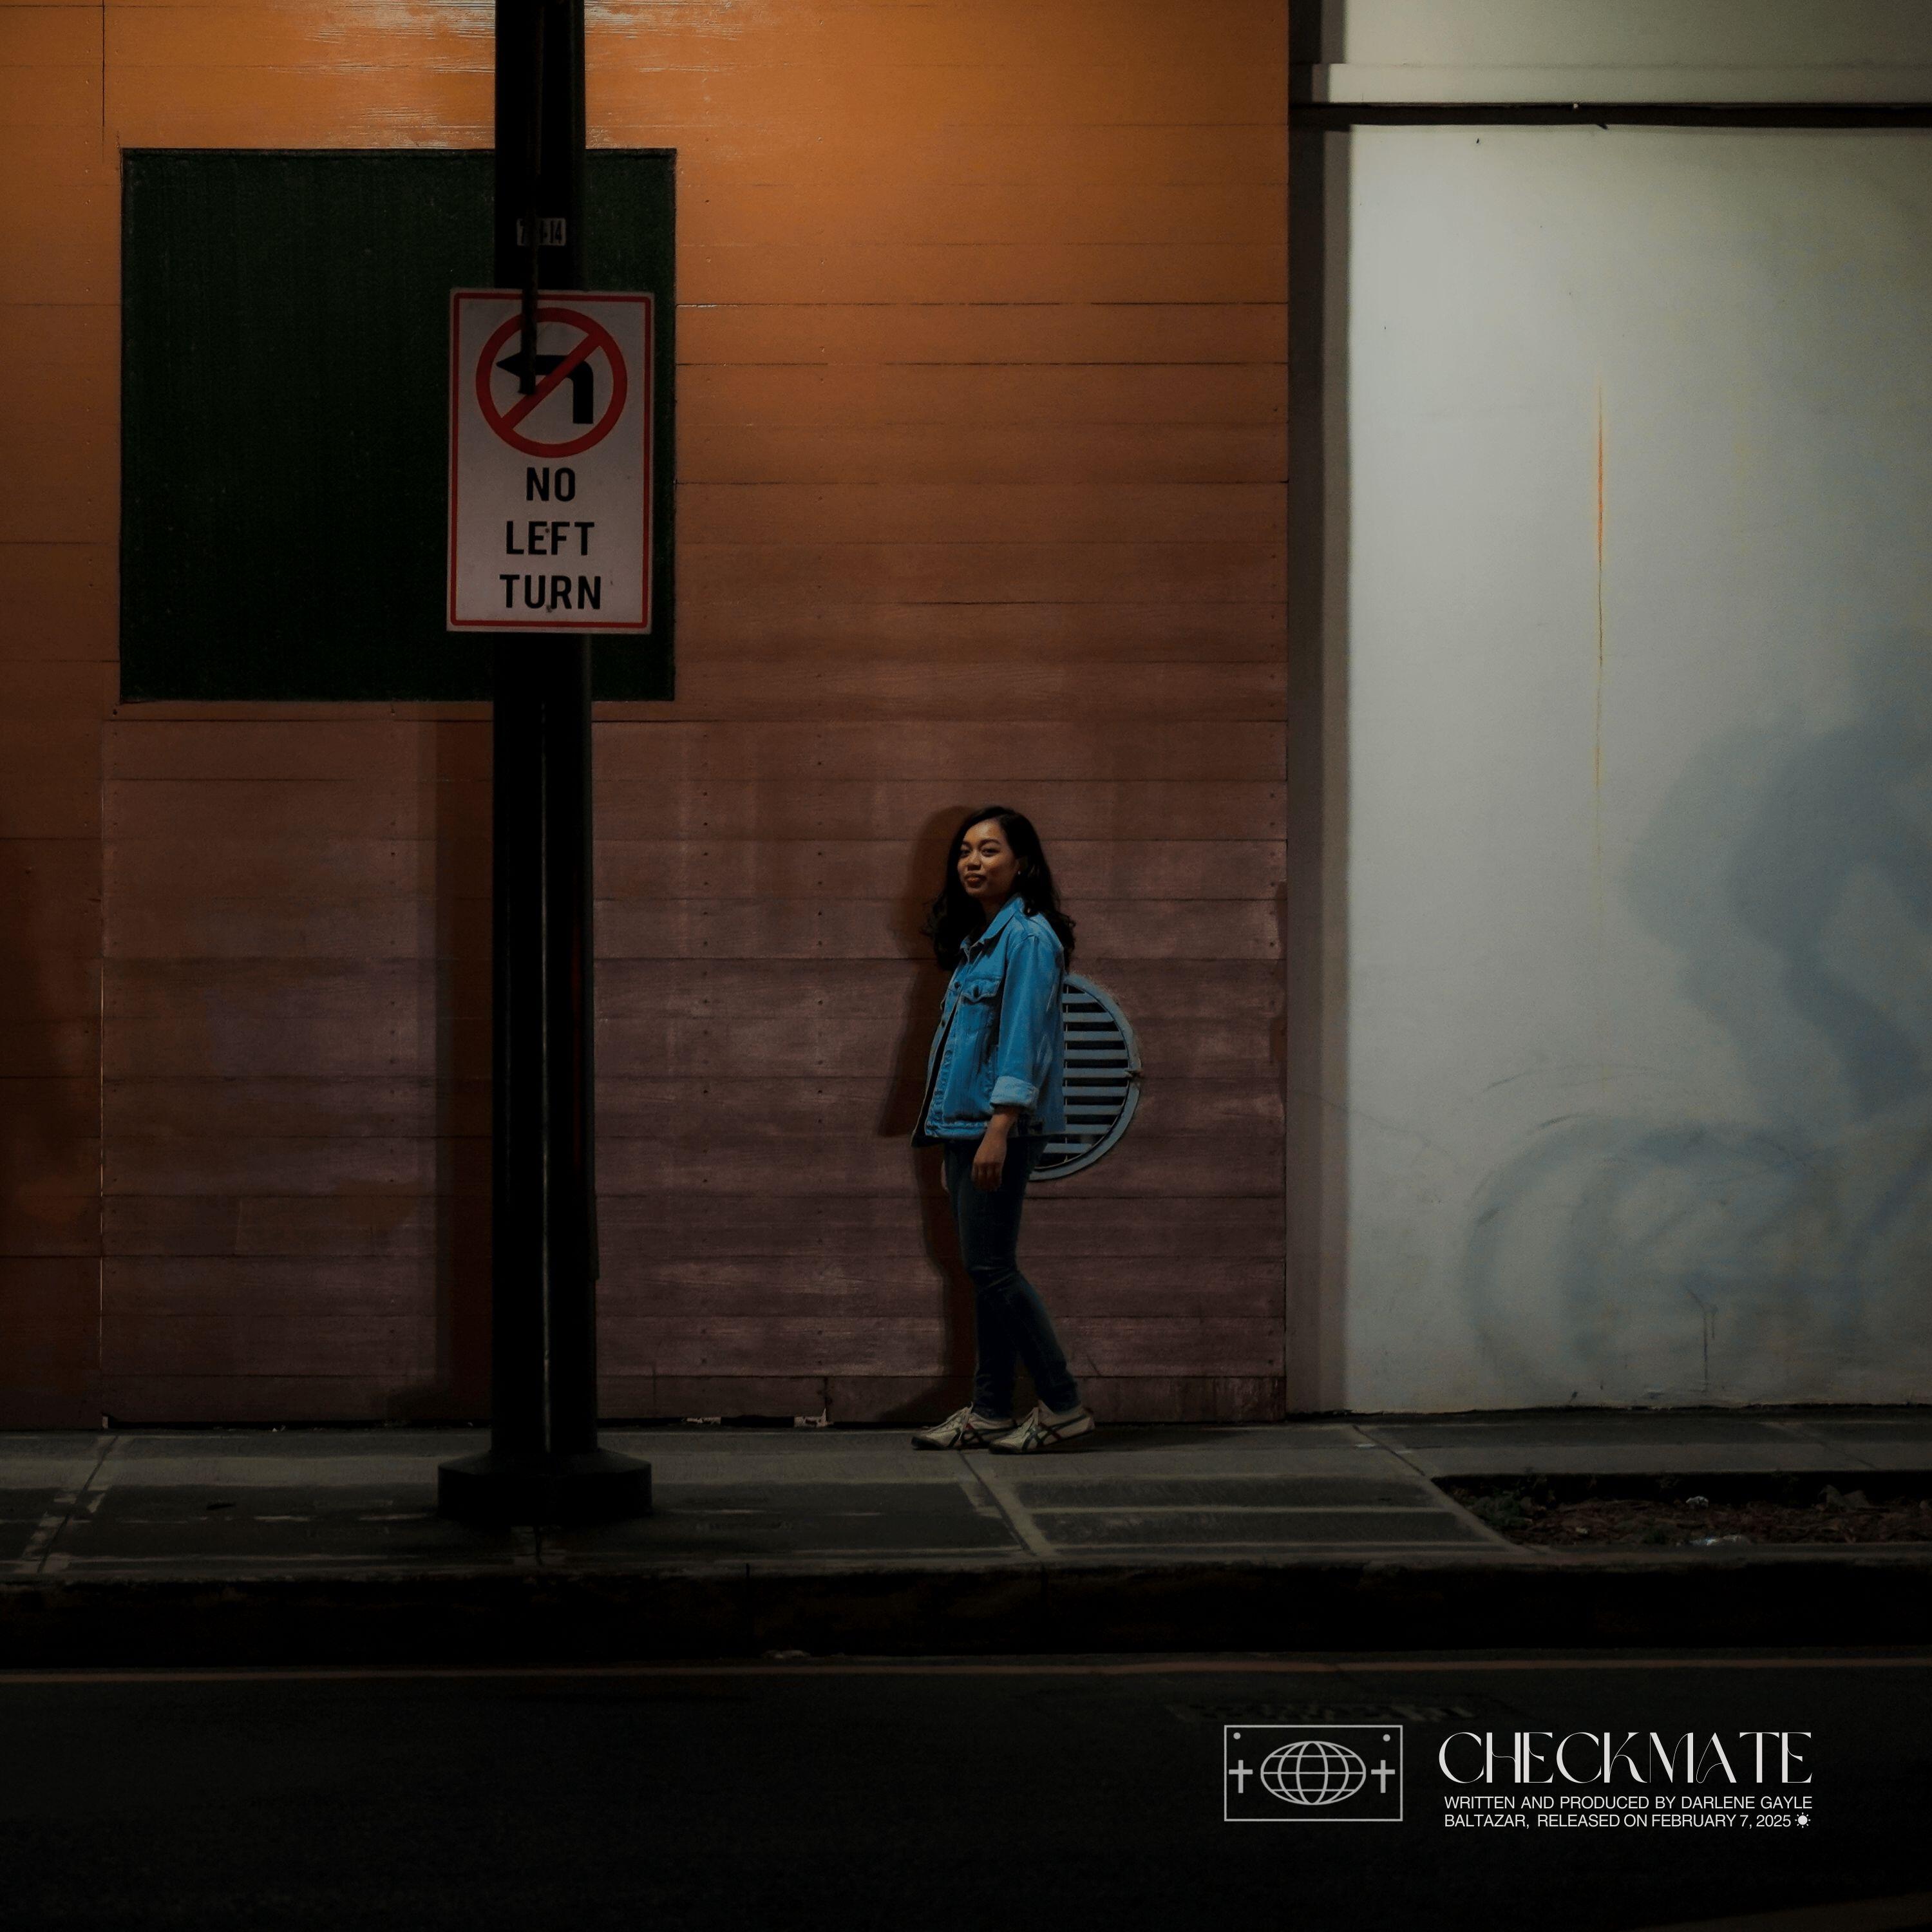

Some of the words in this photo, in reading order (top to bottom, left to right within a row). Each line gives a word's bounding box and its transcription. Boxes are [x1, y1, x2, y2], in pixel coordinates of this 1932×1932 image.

[526, 467, 575, 502] NO
[506, 521, 594, 555] LEFT
[500, 574, 601, 610] TURN
